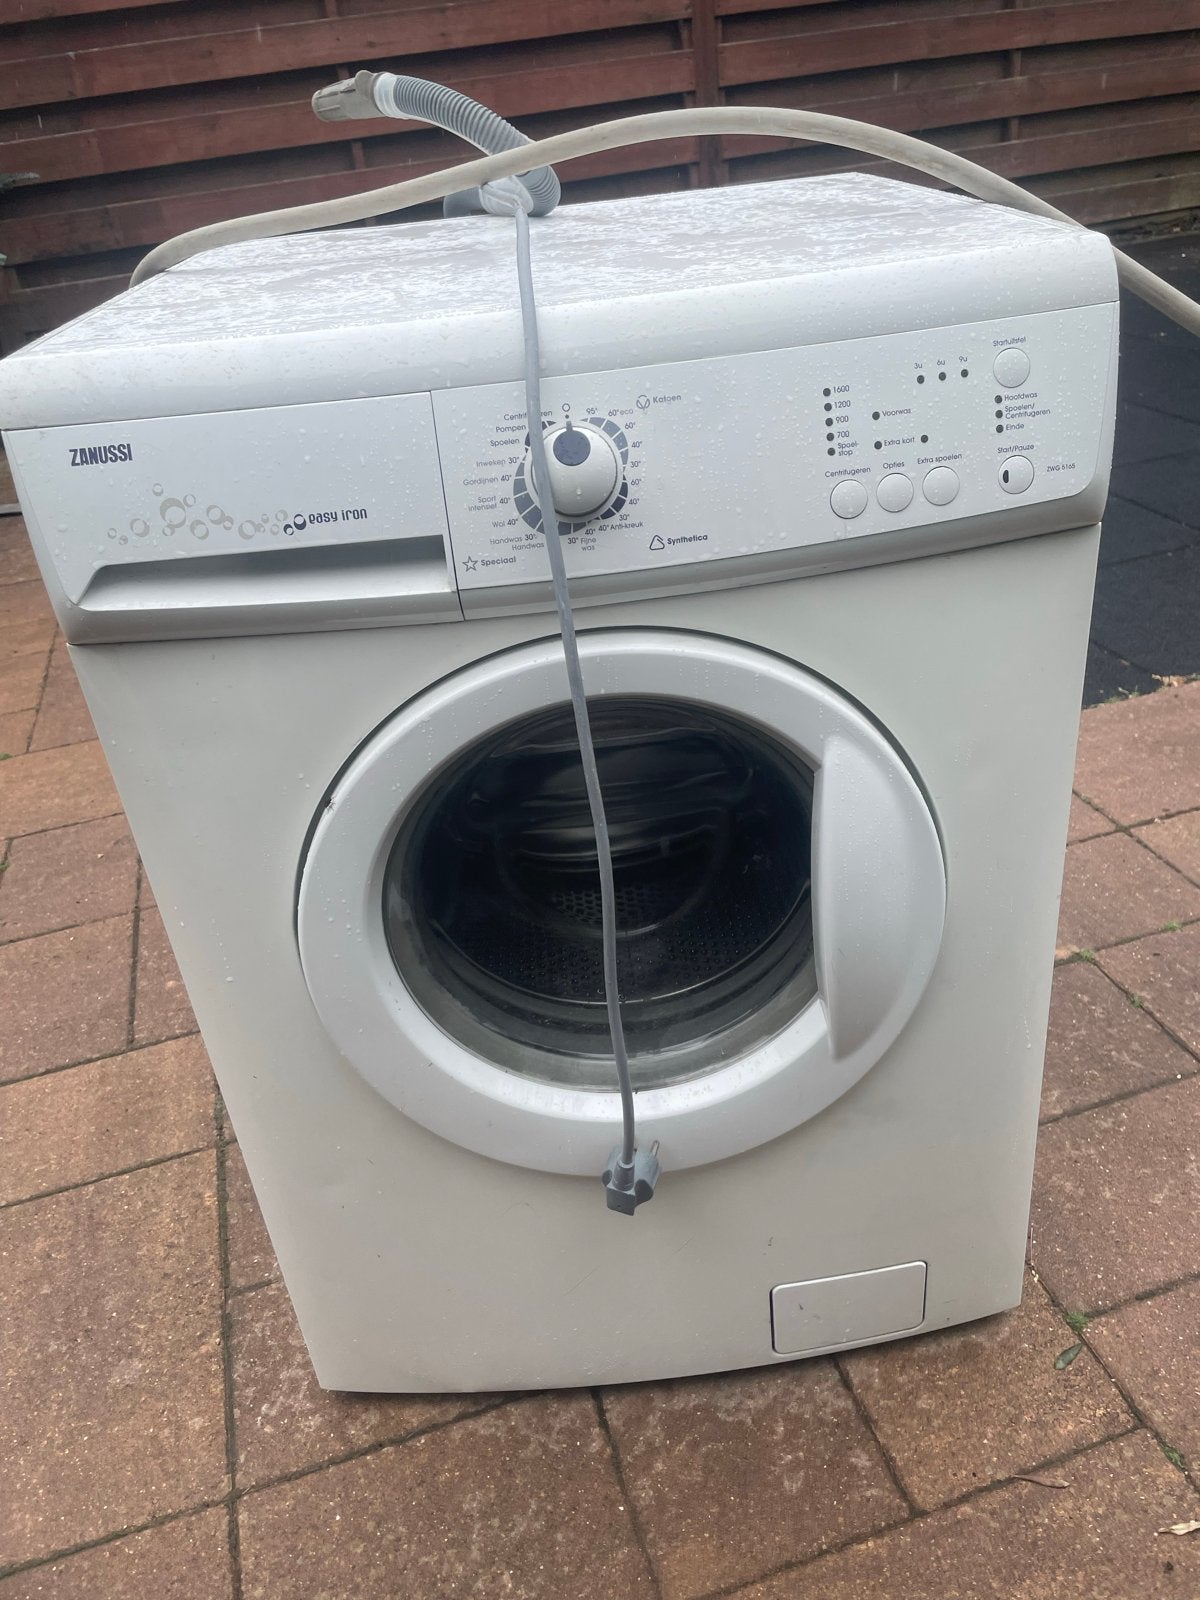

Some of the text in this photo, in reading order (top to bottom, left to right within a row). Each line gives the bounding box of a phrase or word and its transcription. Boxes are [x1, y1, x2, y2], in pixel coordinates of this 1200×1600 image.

[833, 385, 850, 394] 1600
[653, 394, 681, 404] Katoen
[1004, 391, 1038, 401] Hoofdwas
[834, 400, 851, 409] 1200
[1005, 403, 1035, 412] Spoelen/
[504, 410, 553, 421] Centrifren
[882, 407, 911, 417] Voorwas
[1005, 409, 1050, 420] Centrifugeren
[836, 416, 849, 424] 900
[496, 424, 526, 433] Pompen
[1006, 422, 1025, 431] Einde
[837, 431, 850, 439] 700
[490, 437, 520, 447] Spoelen
[884, 436, 915, 447] Extra kort
[839, 449, 853, 457] stop
[997, 444, 1034, 454] Start/Pauze
[69, 443, 133, 466] ZANUSSI
[917, 453, 962, 465] Extra spoelen
[476, 459, 506, 467] Inweken
[630, 460, 641, 468] 30°
[883, 460, 905, 470] Opties
[825, 466, 871, 478] Centrifugeren
[463, 474, 512, 486] Gordijnen 40°
[630, 478, 641, 486] 60°
[308, 509, 367, 524] easy iron
[492, 518, 518, 528] Wol 40°
[610, 521, 643, 530] Anti-kreuk
[490, 536, 523, 545] Handwas
[580, 537, 596, 545] Fijne
[667, 534, 708, 544] Synthetica
[512, 542, 544, 551] Handwas
[481, 556, 516, 566] Speciaal
